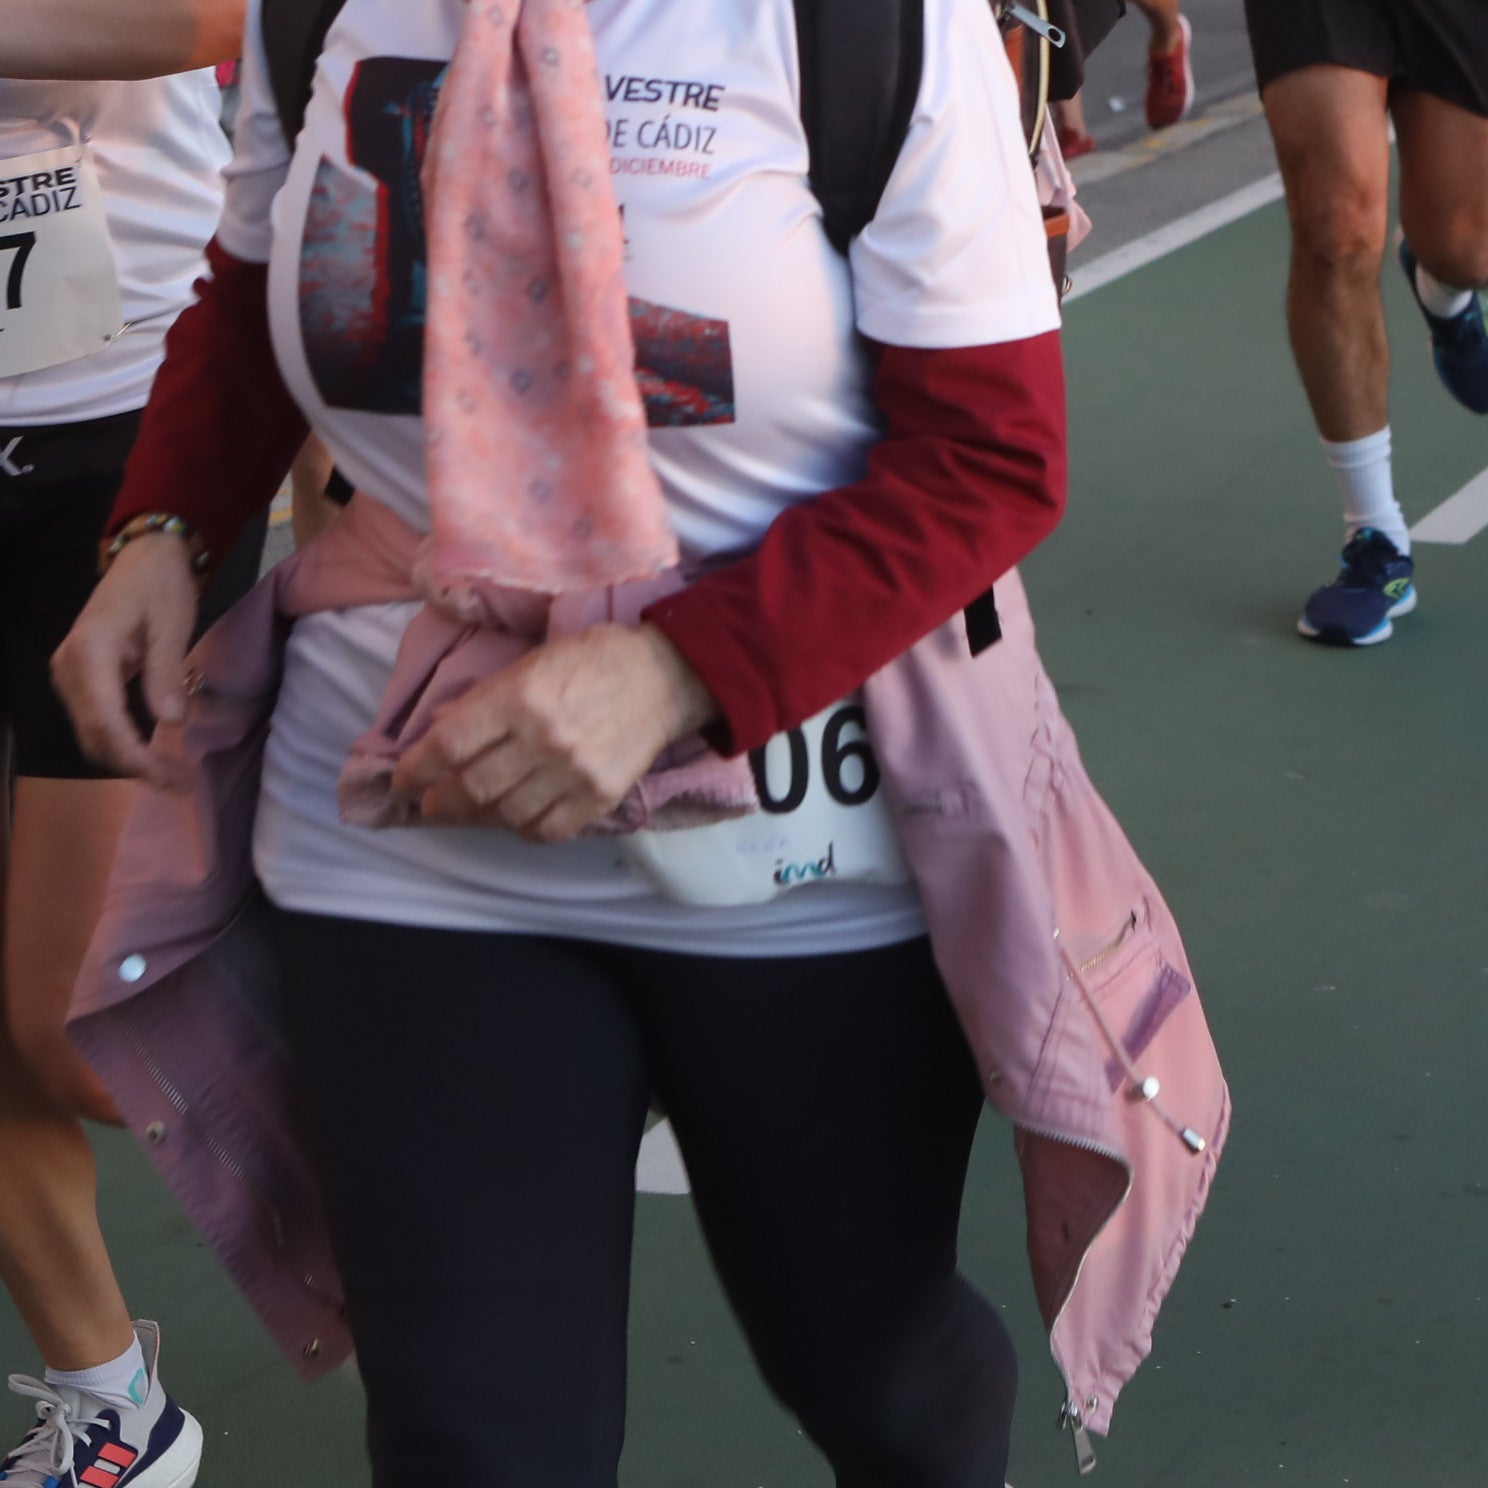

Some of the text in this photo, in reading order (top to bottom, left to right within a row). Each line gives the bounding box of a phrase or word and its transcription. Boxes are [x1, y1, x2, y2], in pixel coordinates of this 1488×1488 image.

[605, 74, 726, 112] VESTRE
[605, 112, 718, 156] E CÁDIZ
[608, 157, 713, 181] DICIEMBRE
[773, 840, 836, 885] imd
